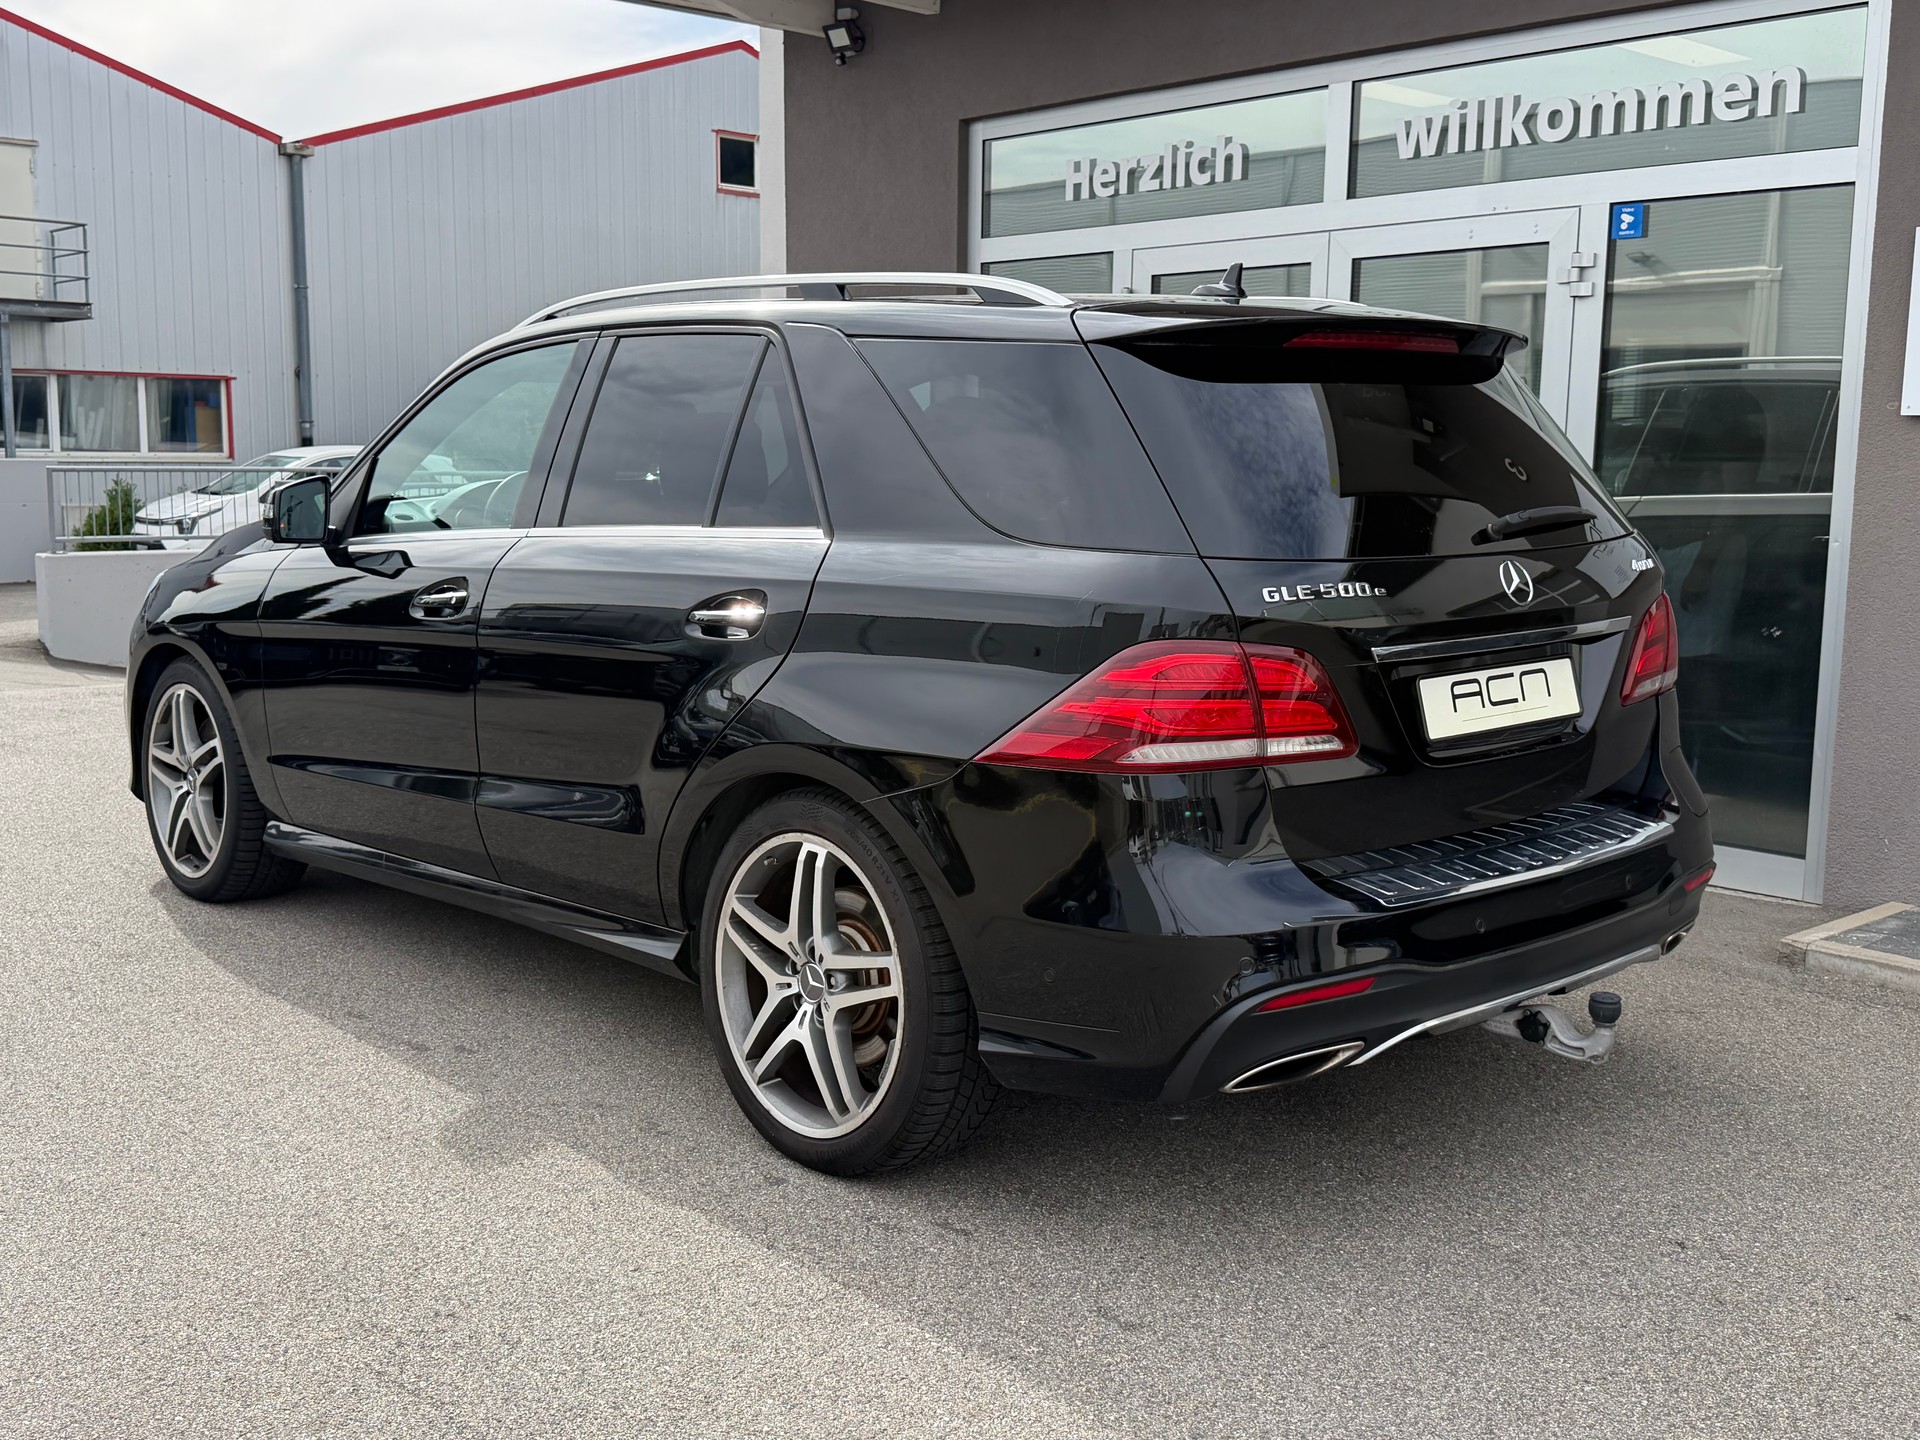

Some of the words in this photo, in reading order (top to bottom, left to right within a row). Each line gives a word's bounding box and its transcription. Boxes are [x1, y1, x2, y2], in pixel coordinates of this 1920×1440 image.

[1065, 134, 1243, 201] Herzlich
[1396, 65, 1803, 160] willkommen
[1262, 584, 1315, 603] GLE
[1450, 667, 1552, 713] ACN
